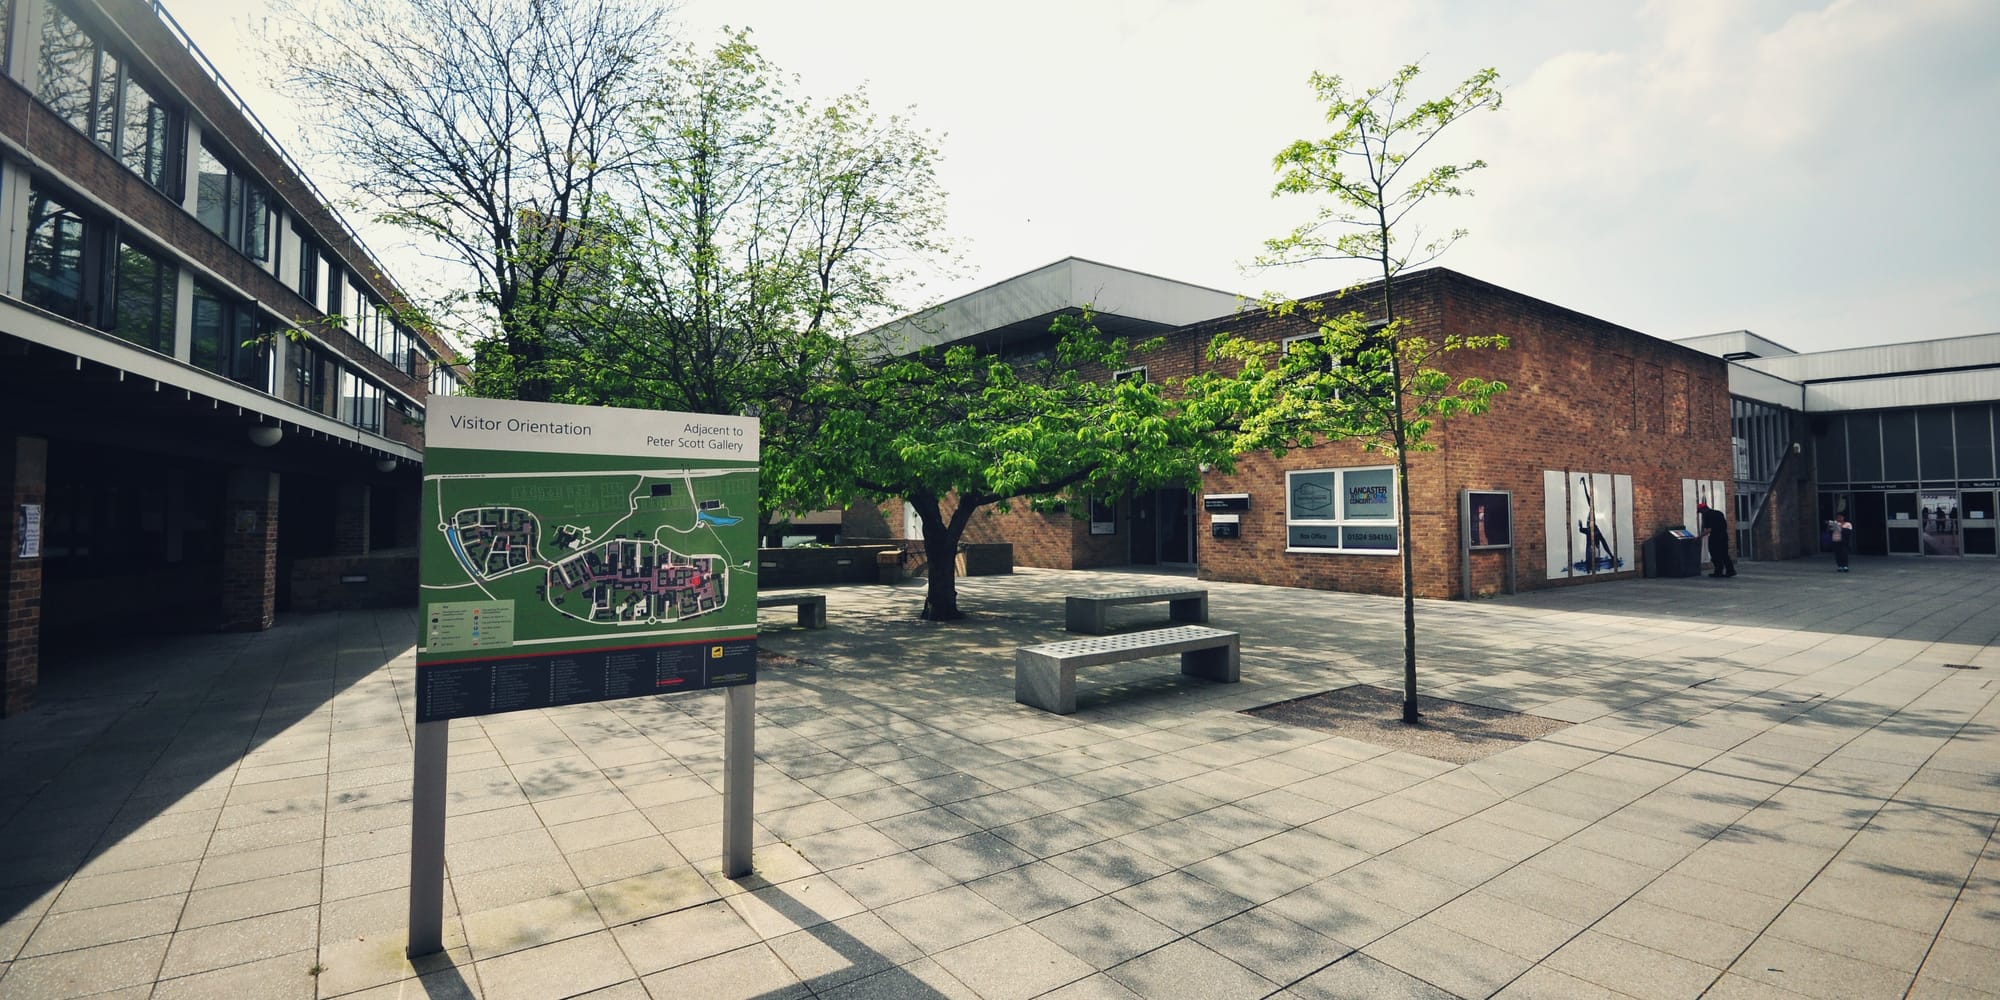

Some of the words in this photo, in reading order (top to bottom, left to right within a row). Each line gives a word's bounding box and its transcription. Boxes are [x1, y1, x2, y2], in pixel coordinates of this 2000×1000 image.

[450, 415, 501, 431] Visitor
[507, 418, 592, 436] Orientation
[683, 423, 729, 436] Adjacent
[733, 426, 743, 436] to
[647, 435, 674, 447] Peter
[678, 437, 705, 448] Scott
[708, 438, 743, 452] Gallery
[1349, 486, 1387, 494] LANCASTER
[1346, 533, 1367, 541] 01524
